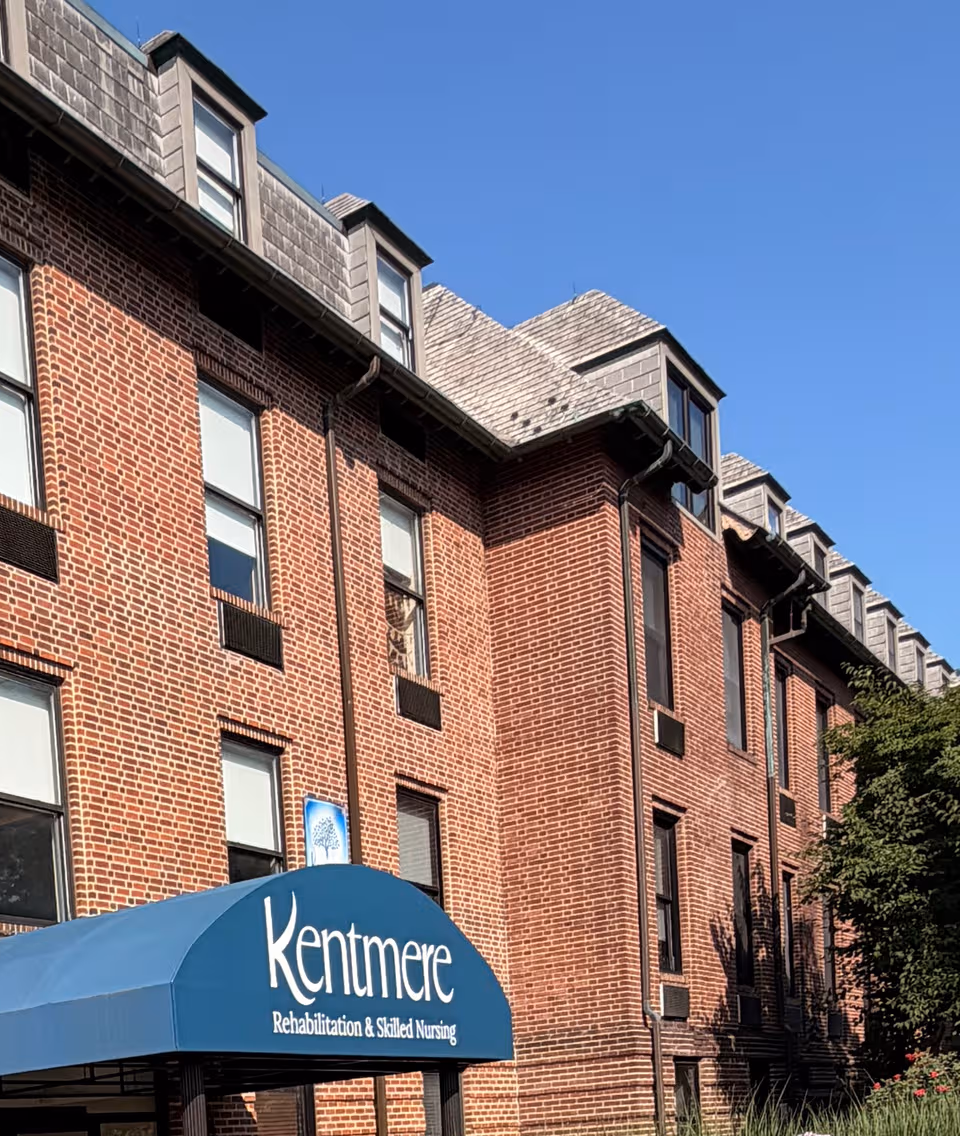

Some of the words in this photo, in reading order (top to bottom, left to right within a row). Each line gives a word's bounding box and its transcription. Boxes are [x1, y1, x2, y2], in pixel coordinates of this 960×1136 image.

[263, 890, 455, 1006] Kentmere
[272, 1010, 362, 1037] Rehabilitation
[364, 1016, 375, 1038] &
[376, 1016, 413, 1039] Skilled
[415, 1019, 457, 1047] Nursing
